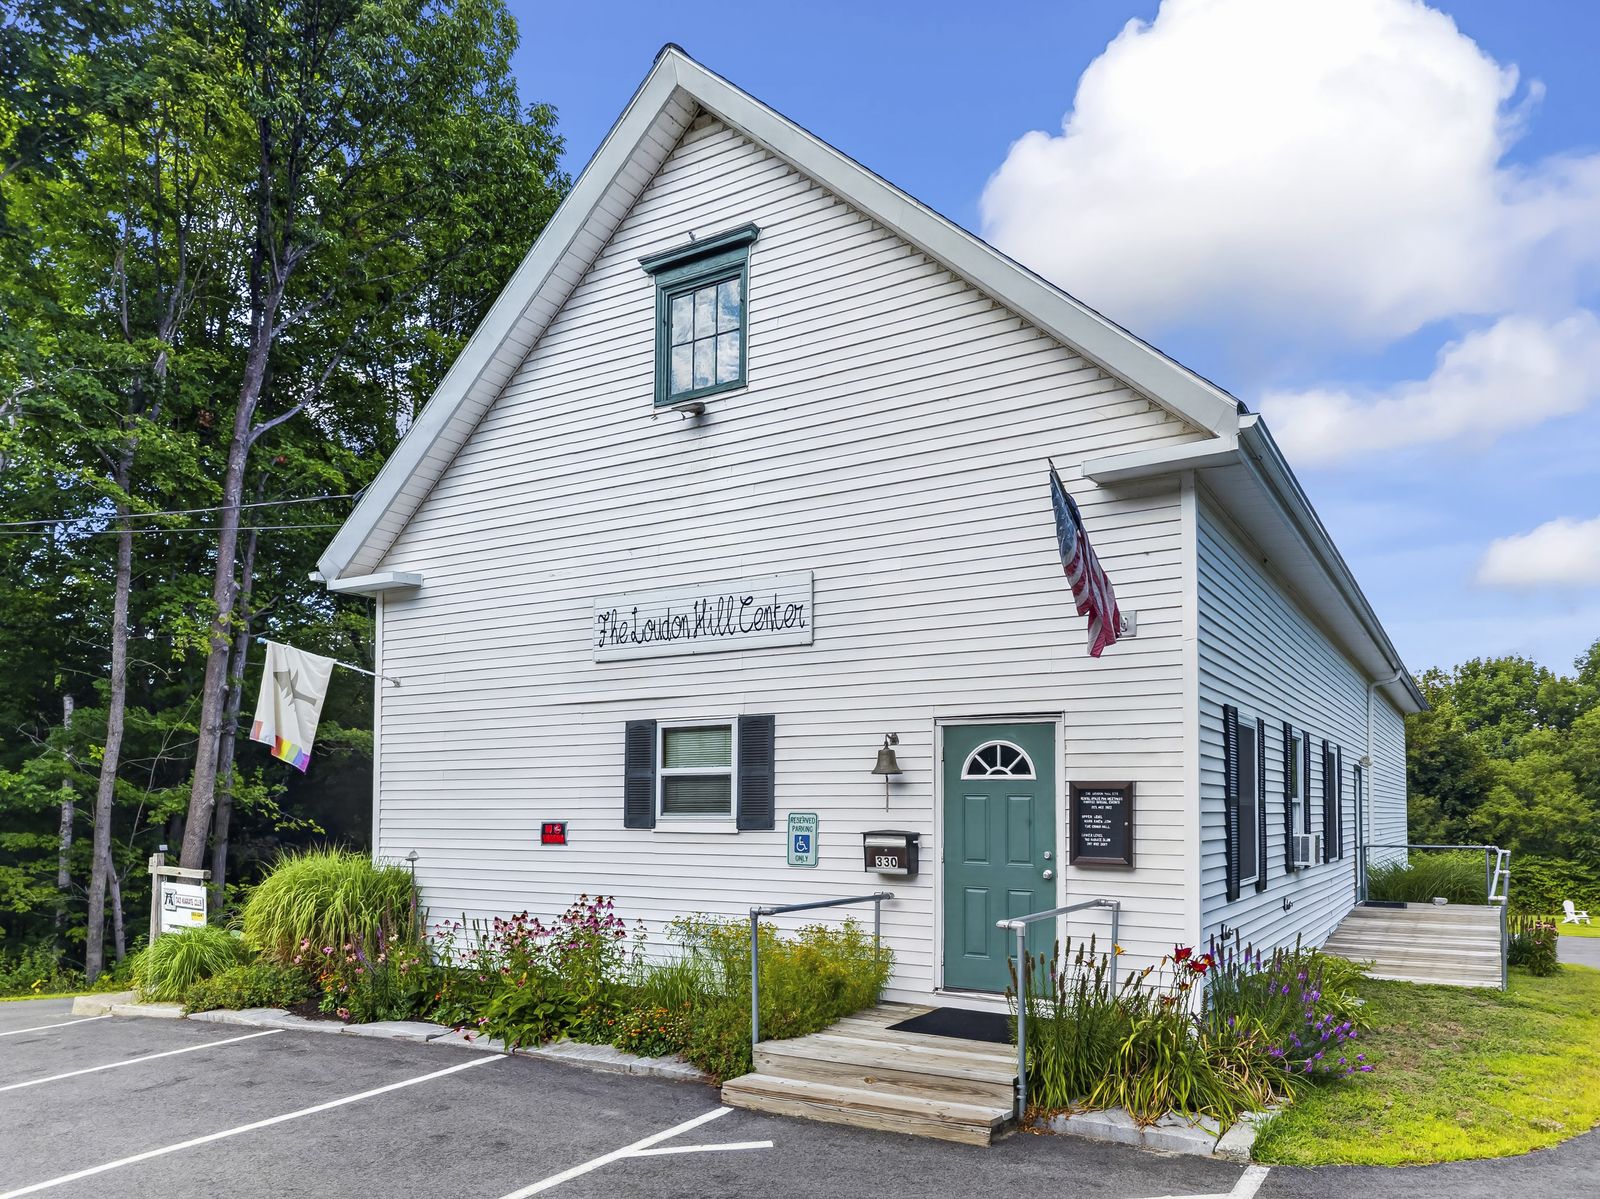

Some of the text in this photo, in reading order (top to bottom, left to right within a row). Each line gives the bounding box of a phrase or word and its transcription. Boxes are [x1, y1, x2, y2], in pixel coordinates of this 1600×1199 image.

[598, 593, 805, 647] The Loudon Hill Center
[790, 815, 816, 824] RESERVED
[791, 825, 814, 833] PARKING
[794, 855, 809, 863] ONLY
[876, 856, 898, 868] 330
